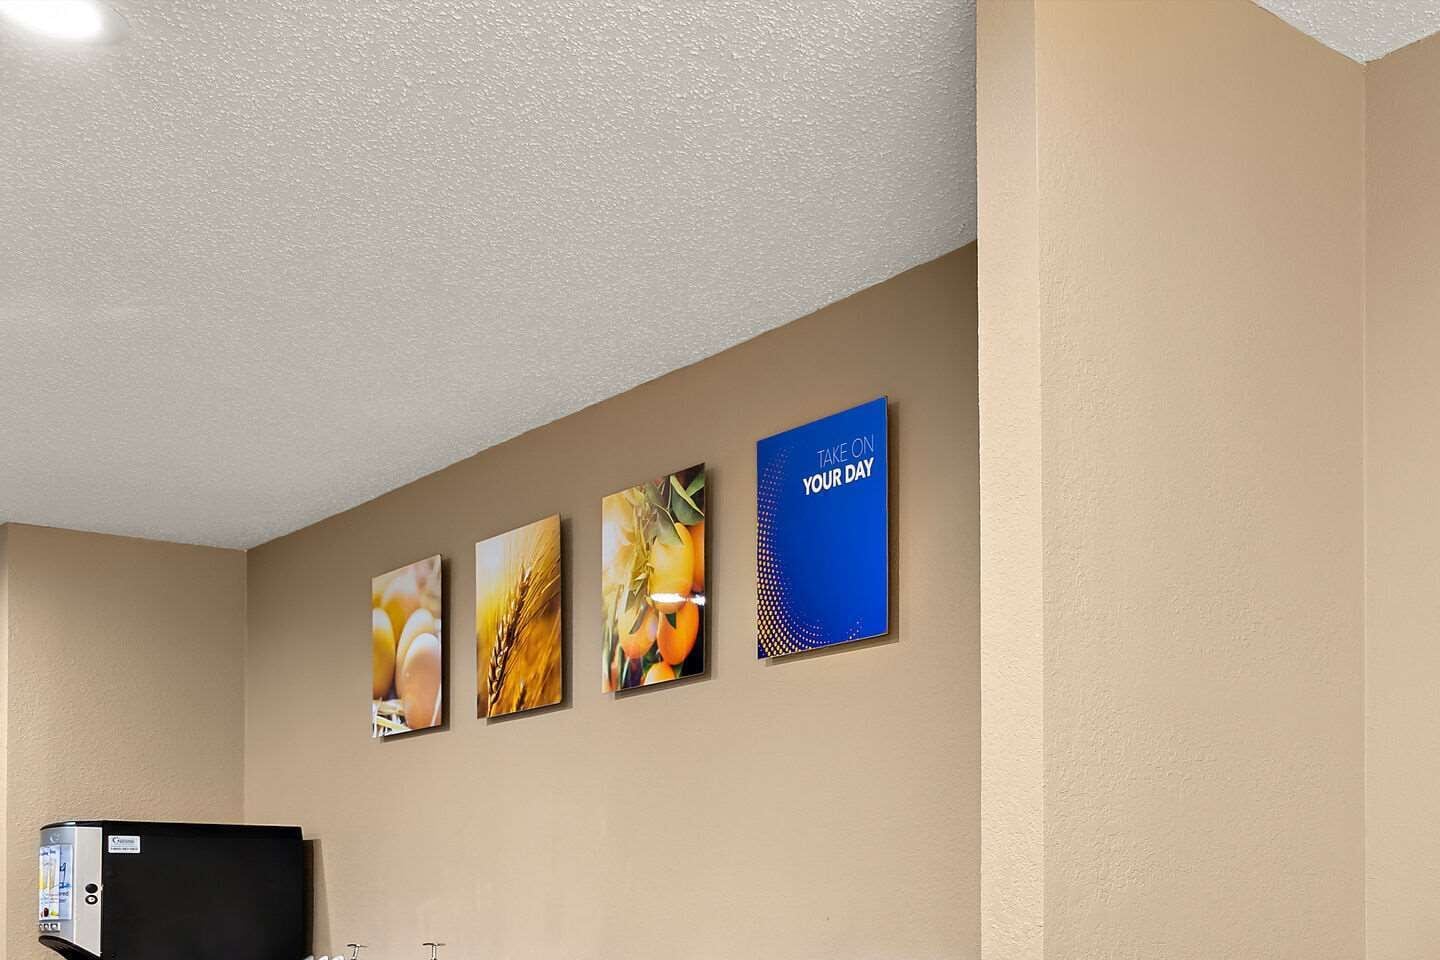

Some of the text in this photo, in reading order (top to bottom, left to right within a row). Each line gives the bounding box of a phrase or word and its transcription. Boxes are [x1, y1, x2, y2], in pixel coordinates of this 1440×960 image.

[817, 434, 874, 468] TAKE ON
[803, 457, 874, 495] YOUR DAY
